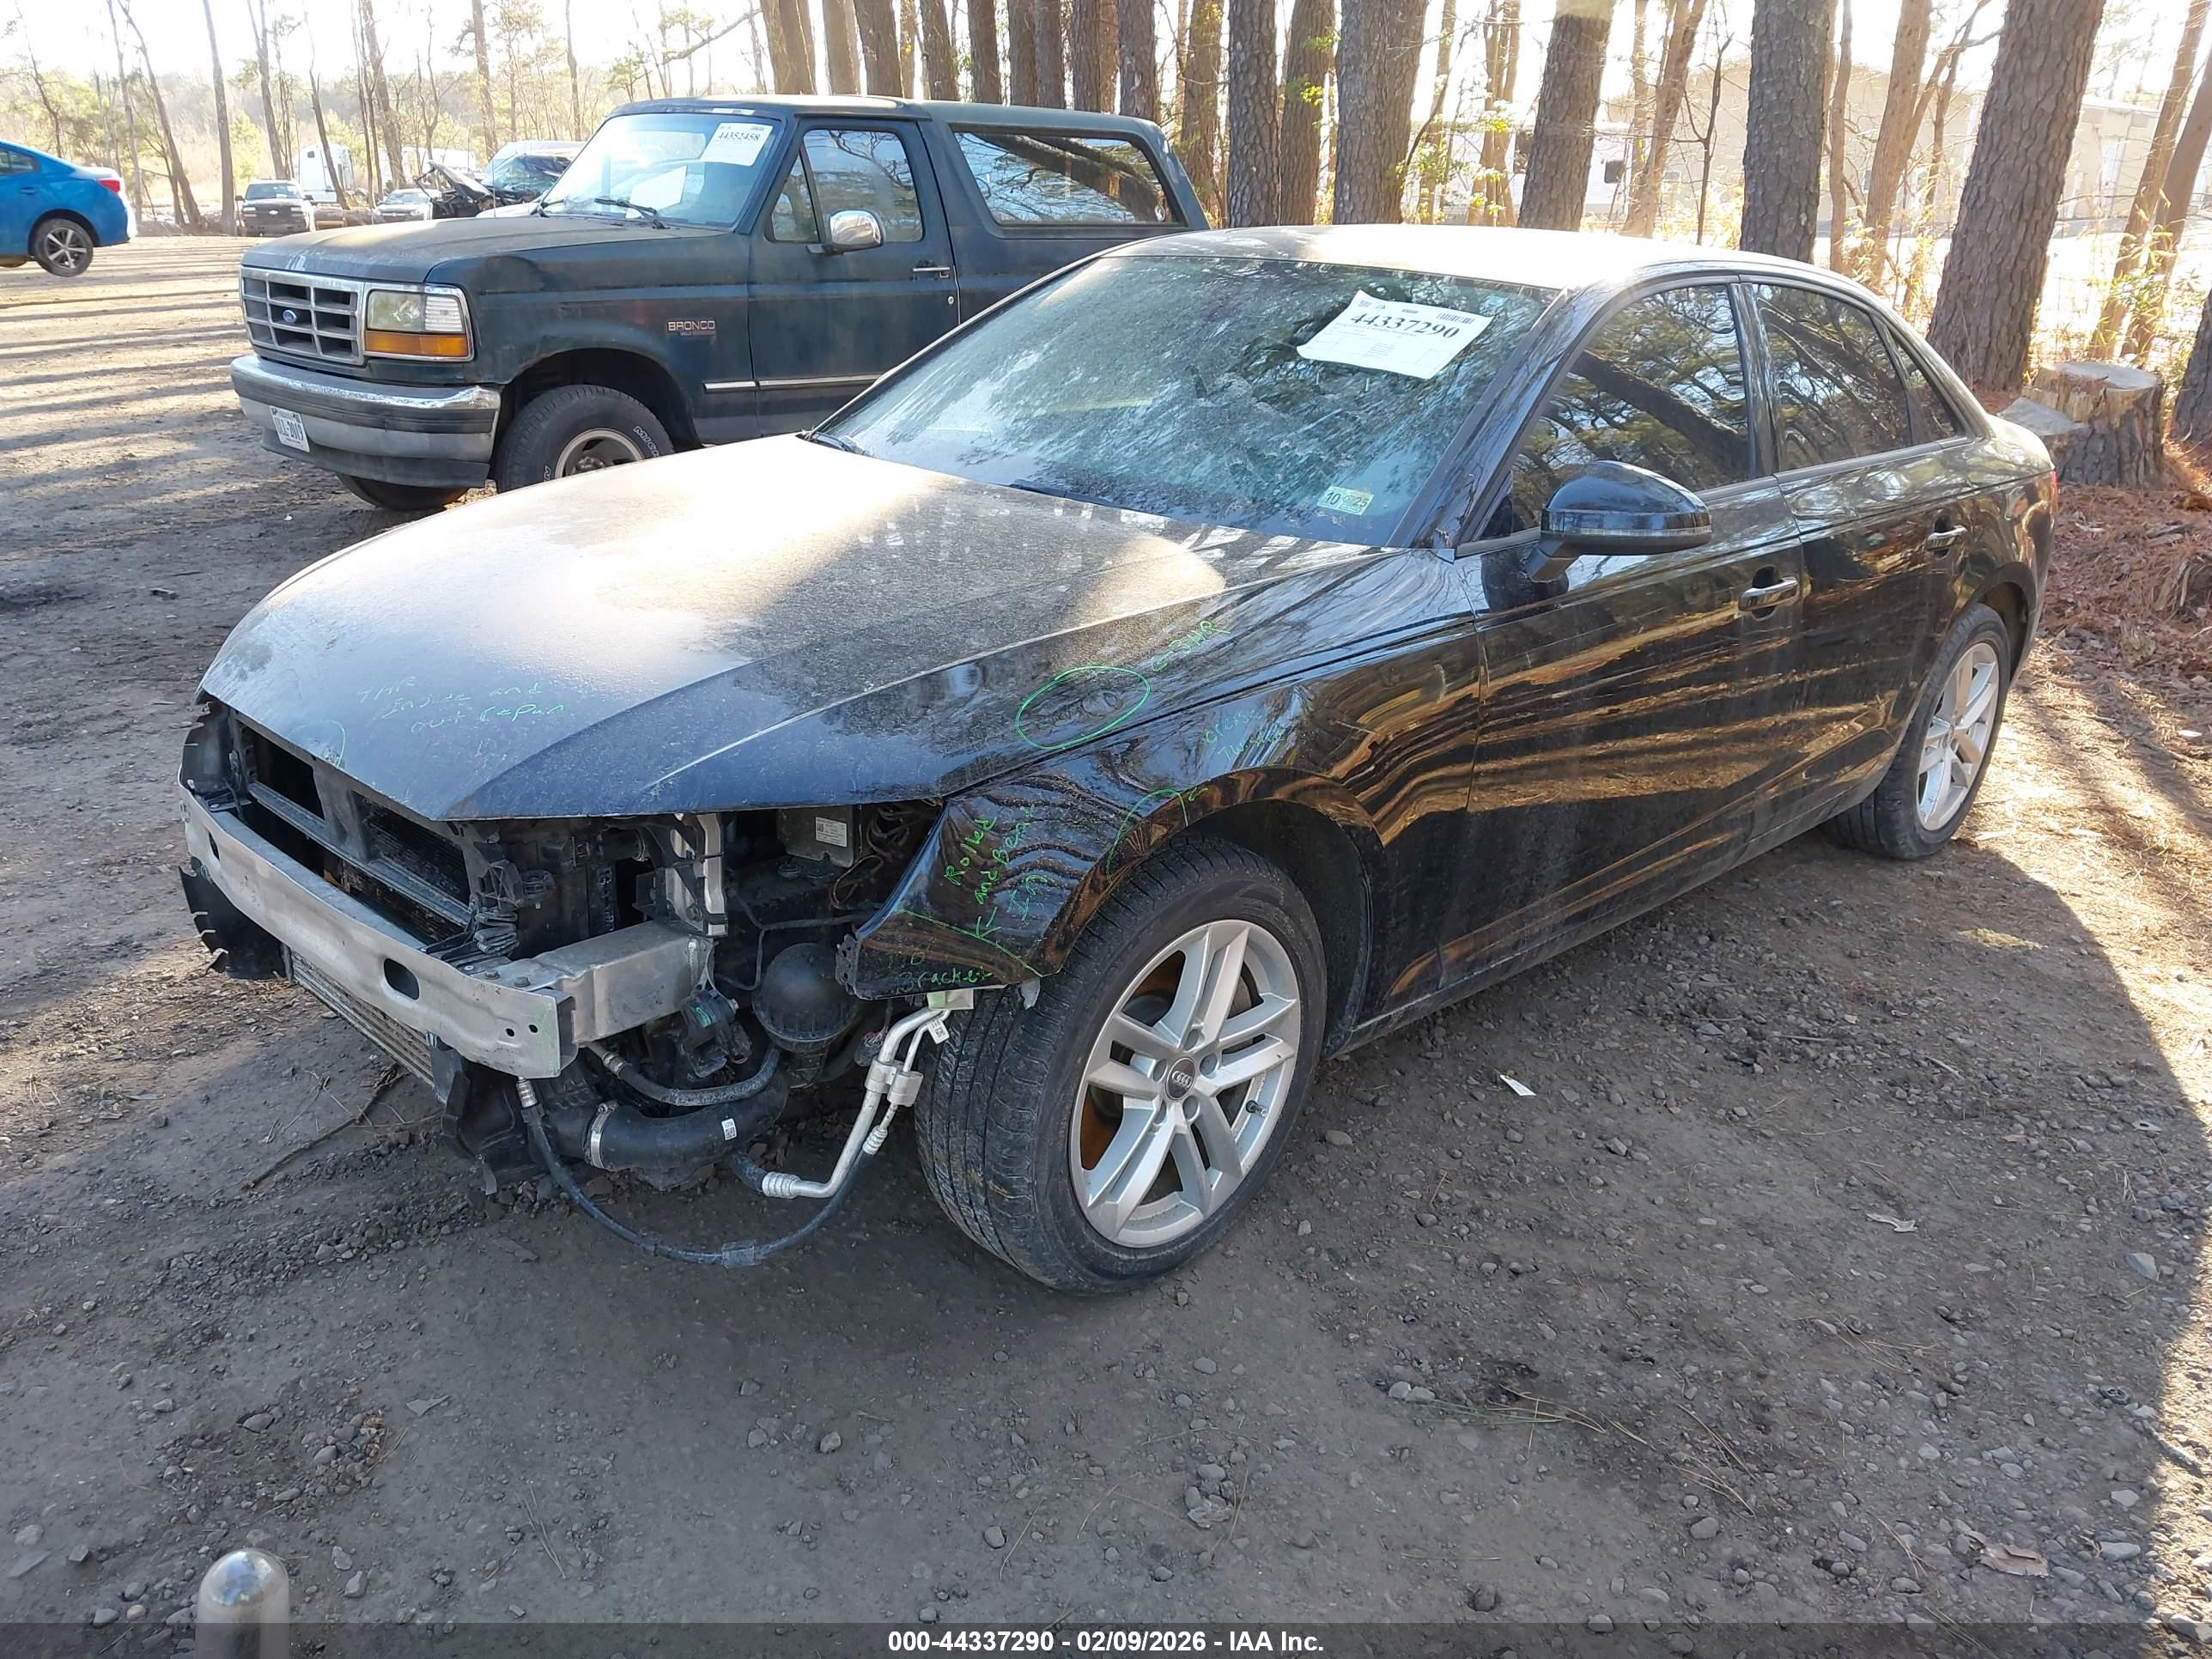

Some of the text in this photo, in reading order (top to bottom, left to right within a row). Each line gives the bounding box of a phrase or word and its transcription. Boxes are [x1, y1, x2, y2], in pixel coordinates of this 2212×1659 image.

[667, 320, 715, 331] BRONCO
[1350, 313, 1461, 338] 44337290
[1325, 491, 1341, 505] 10
[1353, 496, 1370, 507] 25
